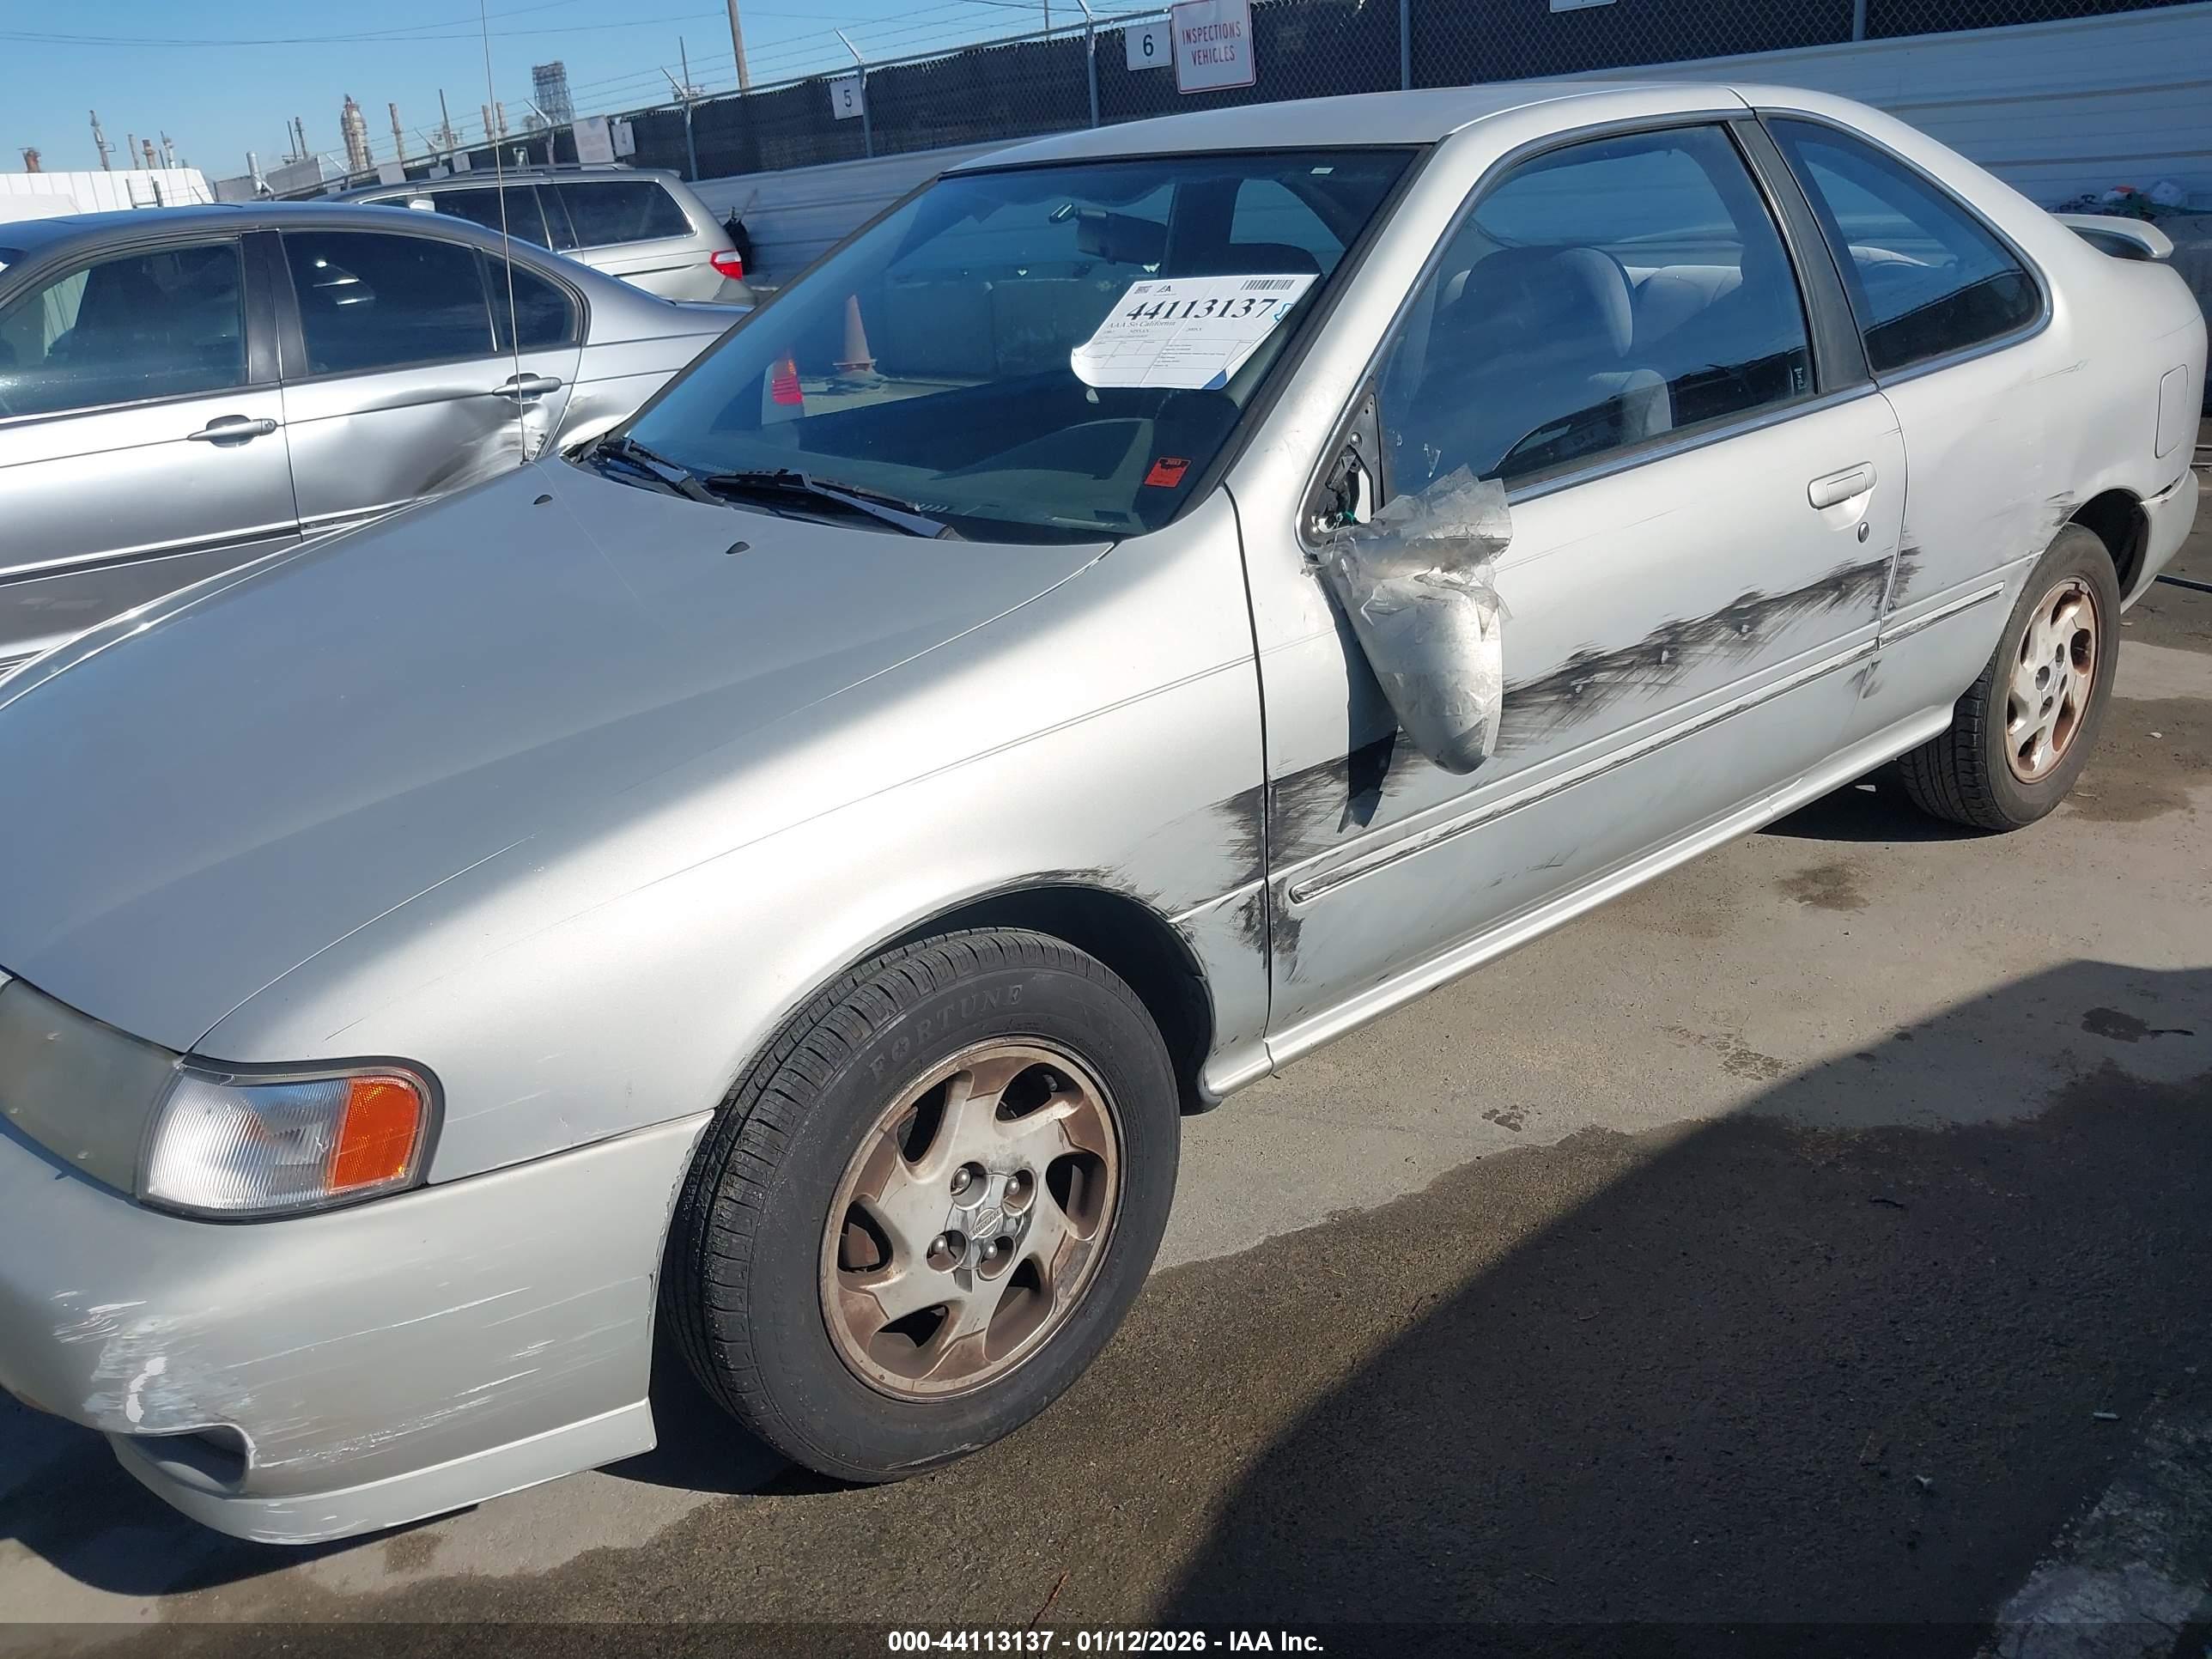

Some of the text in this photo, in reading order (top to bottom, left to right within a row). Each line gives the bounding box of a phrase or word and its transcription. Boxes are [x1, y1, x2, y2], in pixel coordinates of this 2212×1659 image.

[1182, 21, 1242, 46] INSPECTIONS
[1143, 34, 1154, 57] 6
[1191, 45, 1236, 66] VEHICLES
[843, 89, 853, 107] 5
[1126, 298, 1279, 321] 44113137
[1139, 319, 1177, 328] California
[869, 983, 1024, 1079] FORTUNE
